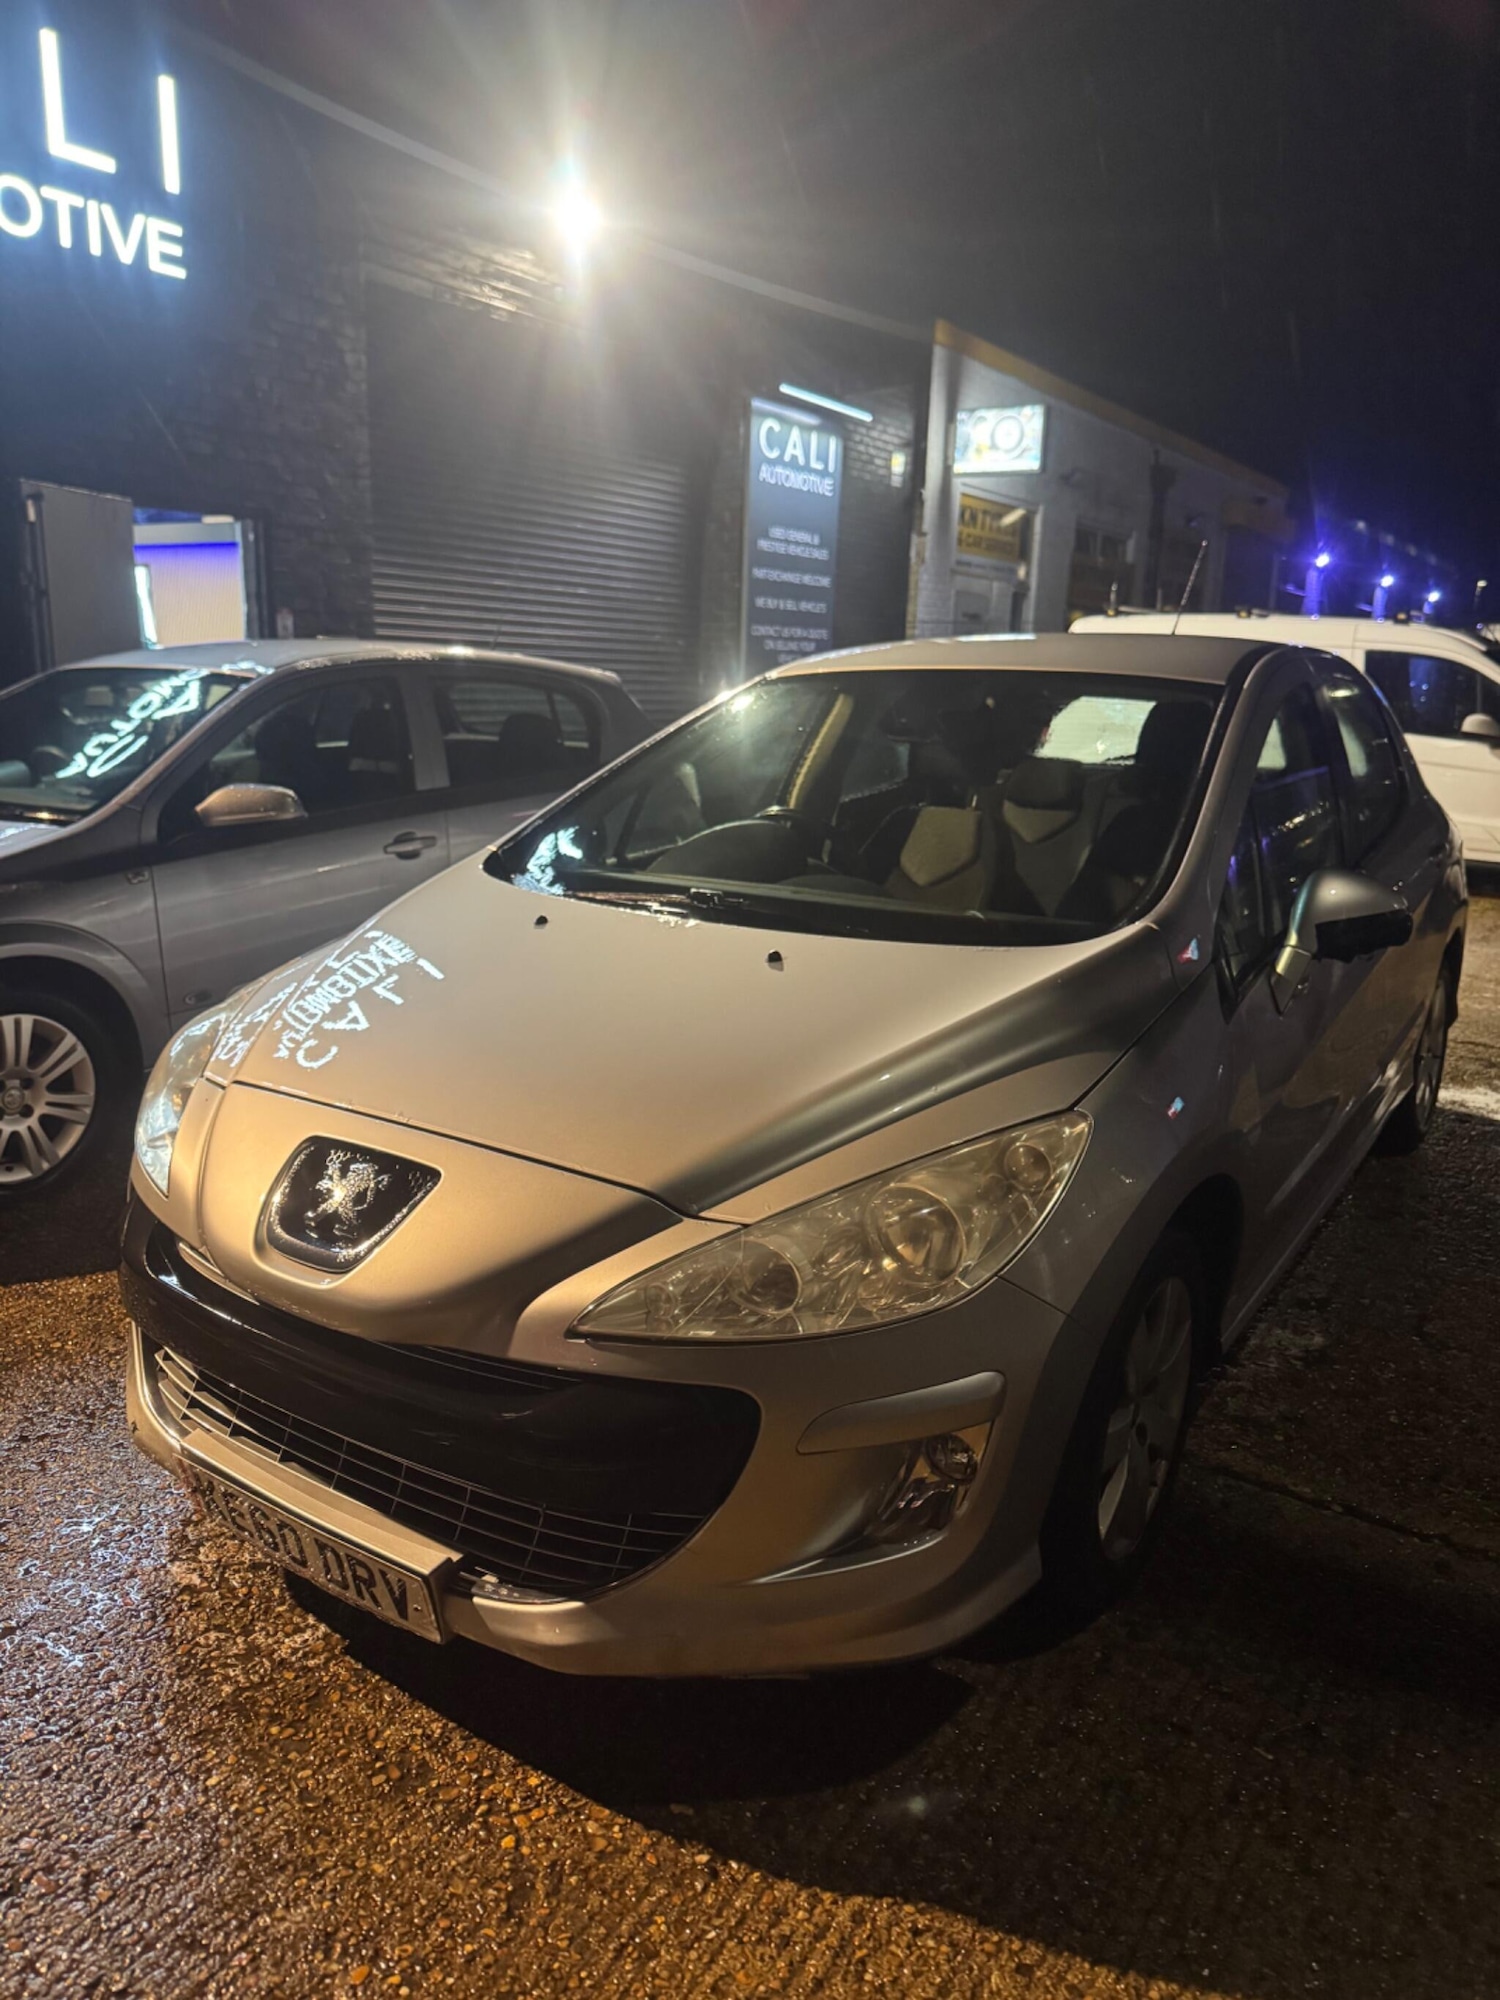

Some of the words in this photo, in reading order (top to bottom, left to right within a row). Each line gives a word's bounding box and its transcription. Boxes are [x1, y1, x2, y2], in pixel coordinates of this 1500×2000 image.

[0, 173, 188, 280] OTIVE
[758, 417, 837, 474] CALI
[758, 462, 835, 498] AUTOMOTIVE
[313, 1536, 408, 1621] DRV
